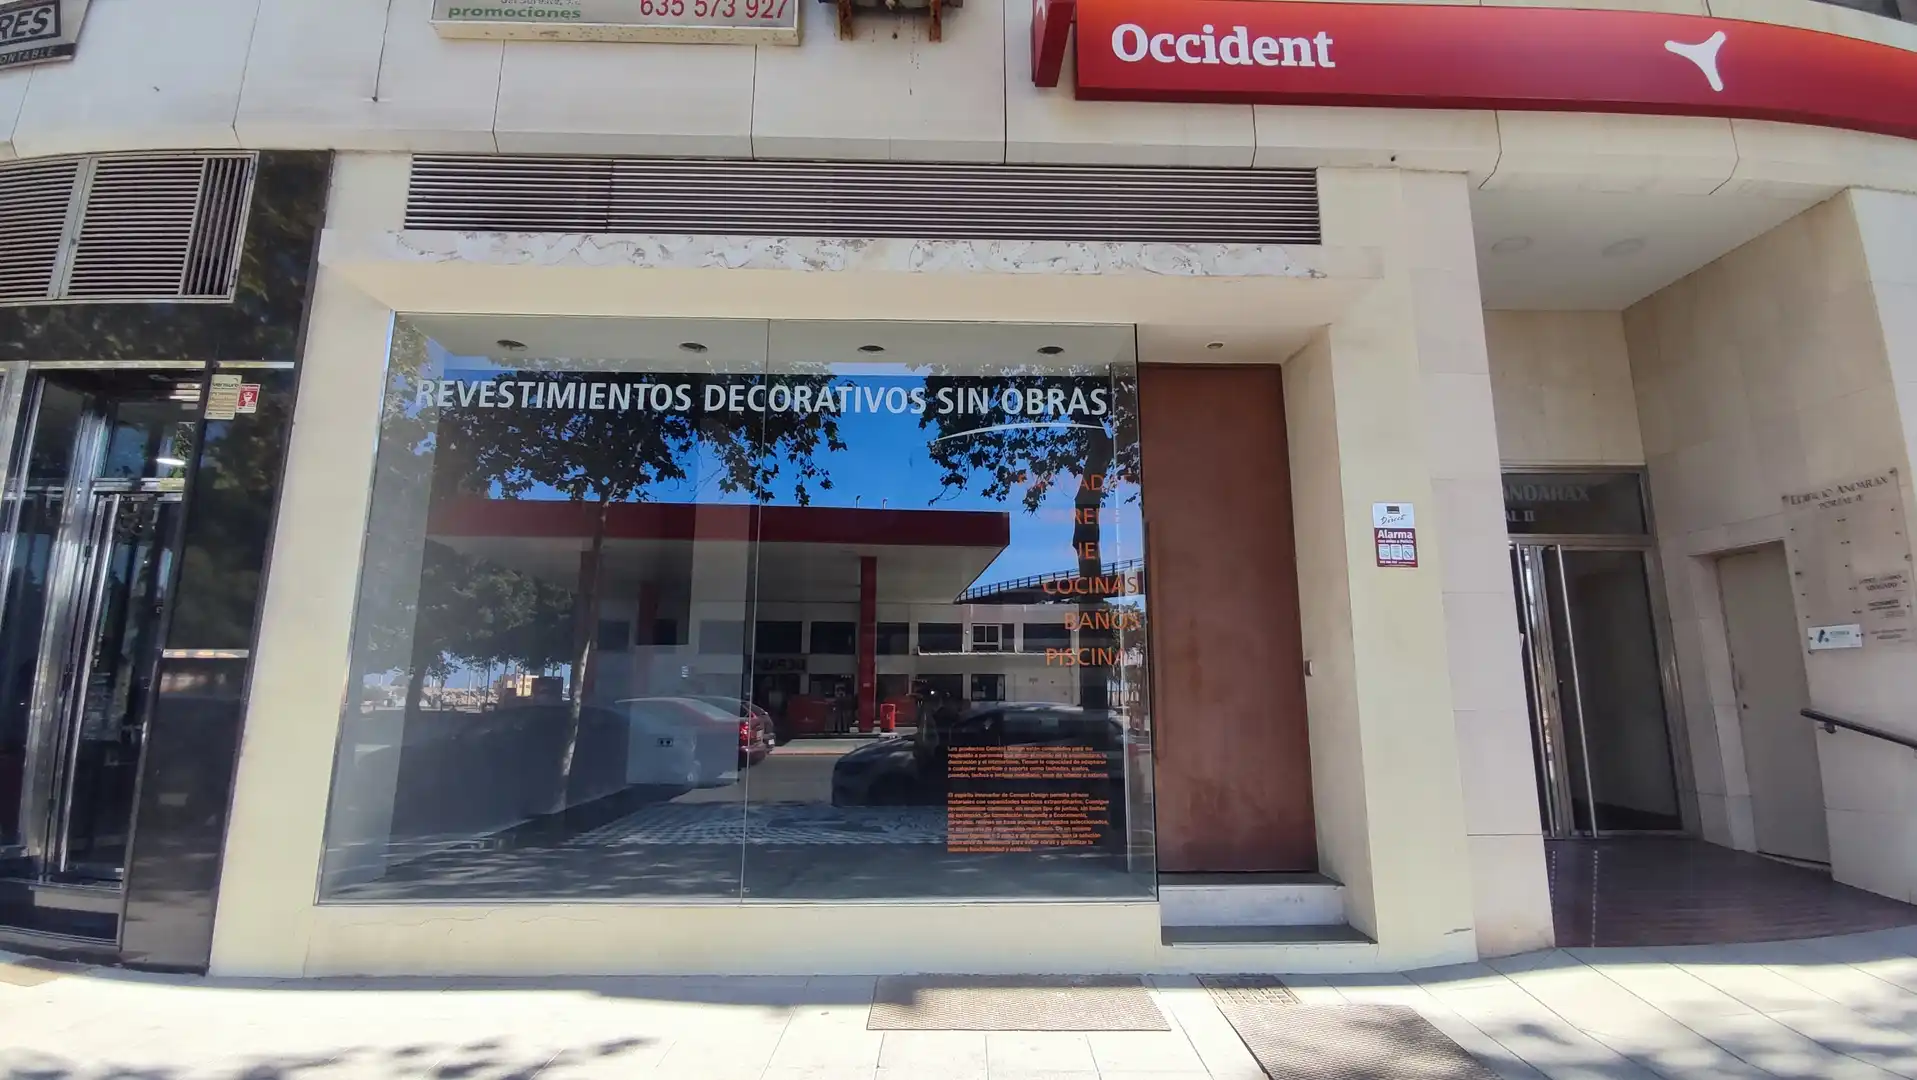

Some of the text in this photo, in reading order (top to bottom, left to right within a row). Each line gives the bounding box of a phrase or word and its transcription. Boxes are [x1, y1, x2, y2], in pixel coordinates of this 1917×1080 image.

[448, 7, 581, 19] promociones
[640, 0, 788, 19] 635 573 927
[1112, 23, 1336, 68] Occident
[415, 379, 1108, 417] REVESTIMIENTOS DECORATIVOS SIN OBRAS
[1378, 529, 1413, 539] Alarma
[1042, 576, 1139, 595] COCINAS
[1065, 608, 1141, 630] BAÑOS
[1045, 647, 1142, 667] PISCINA
